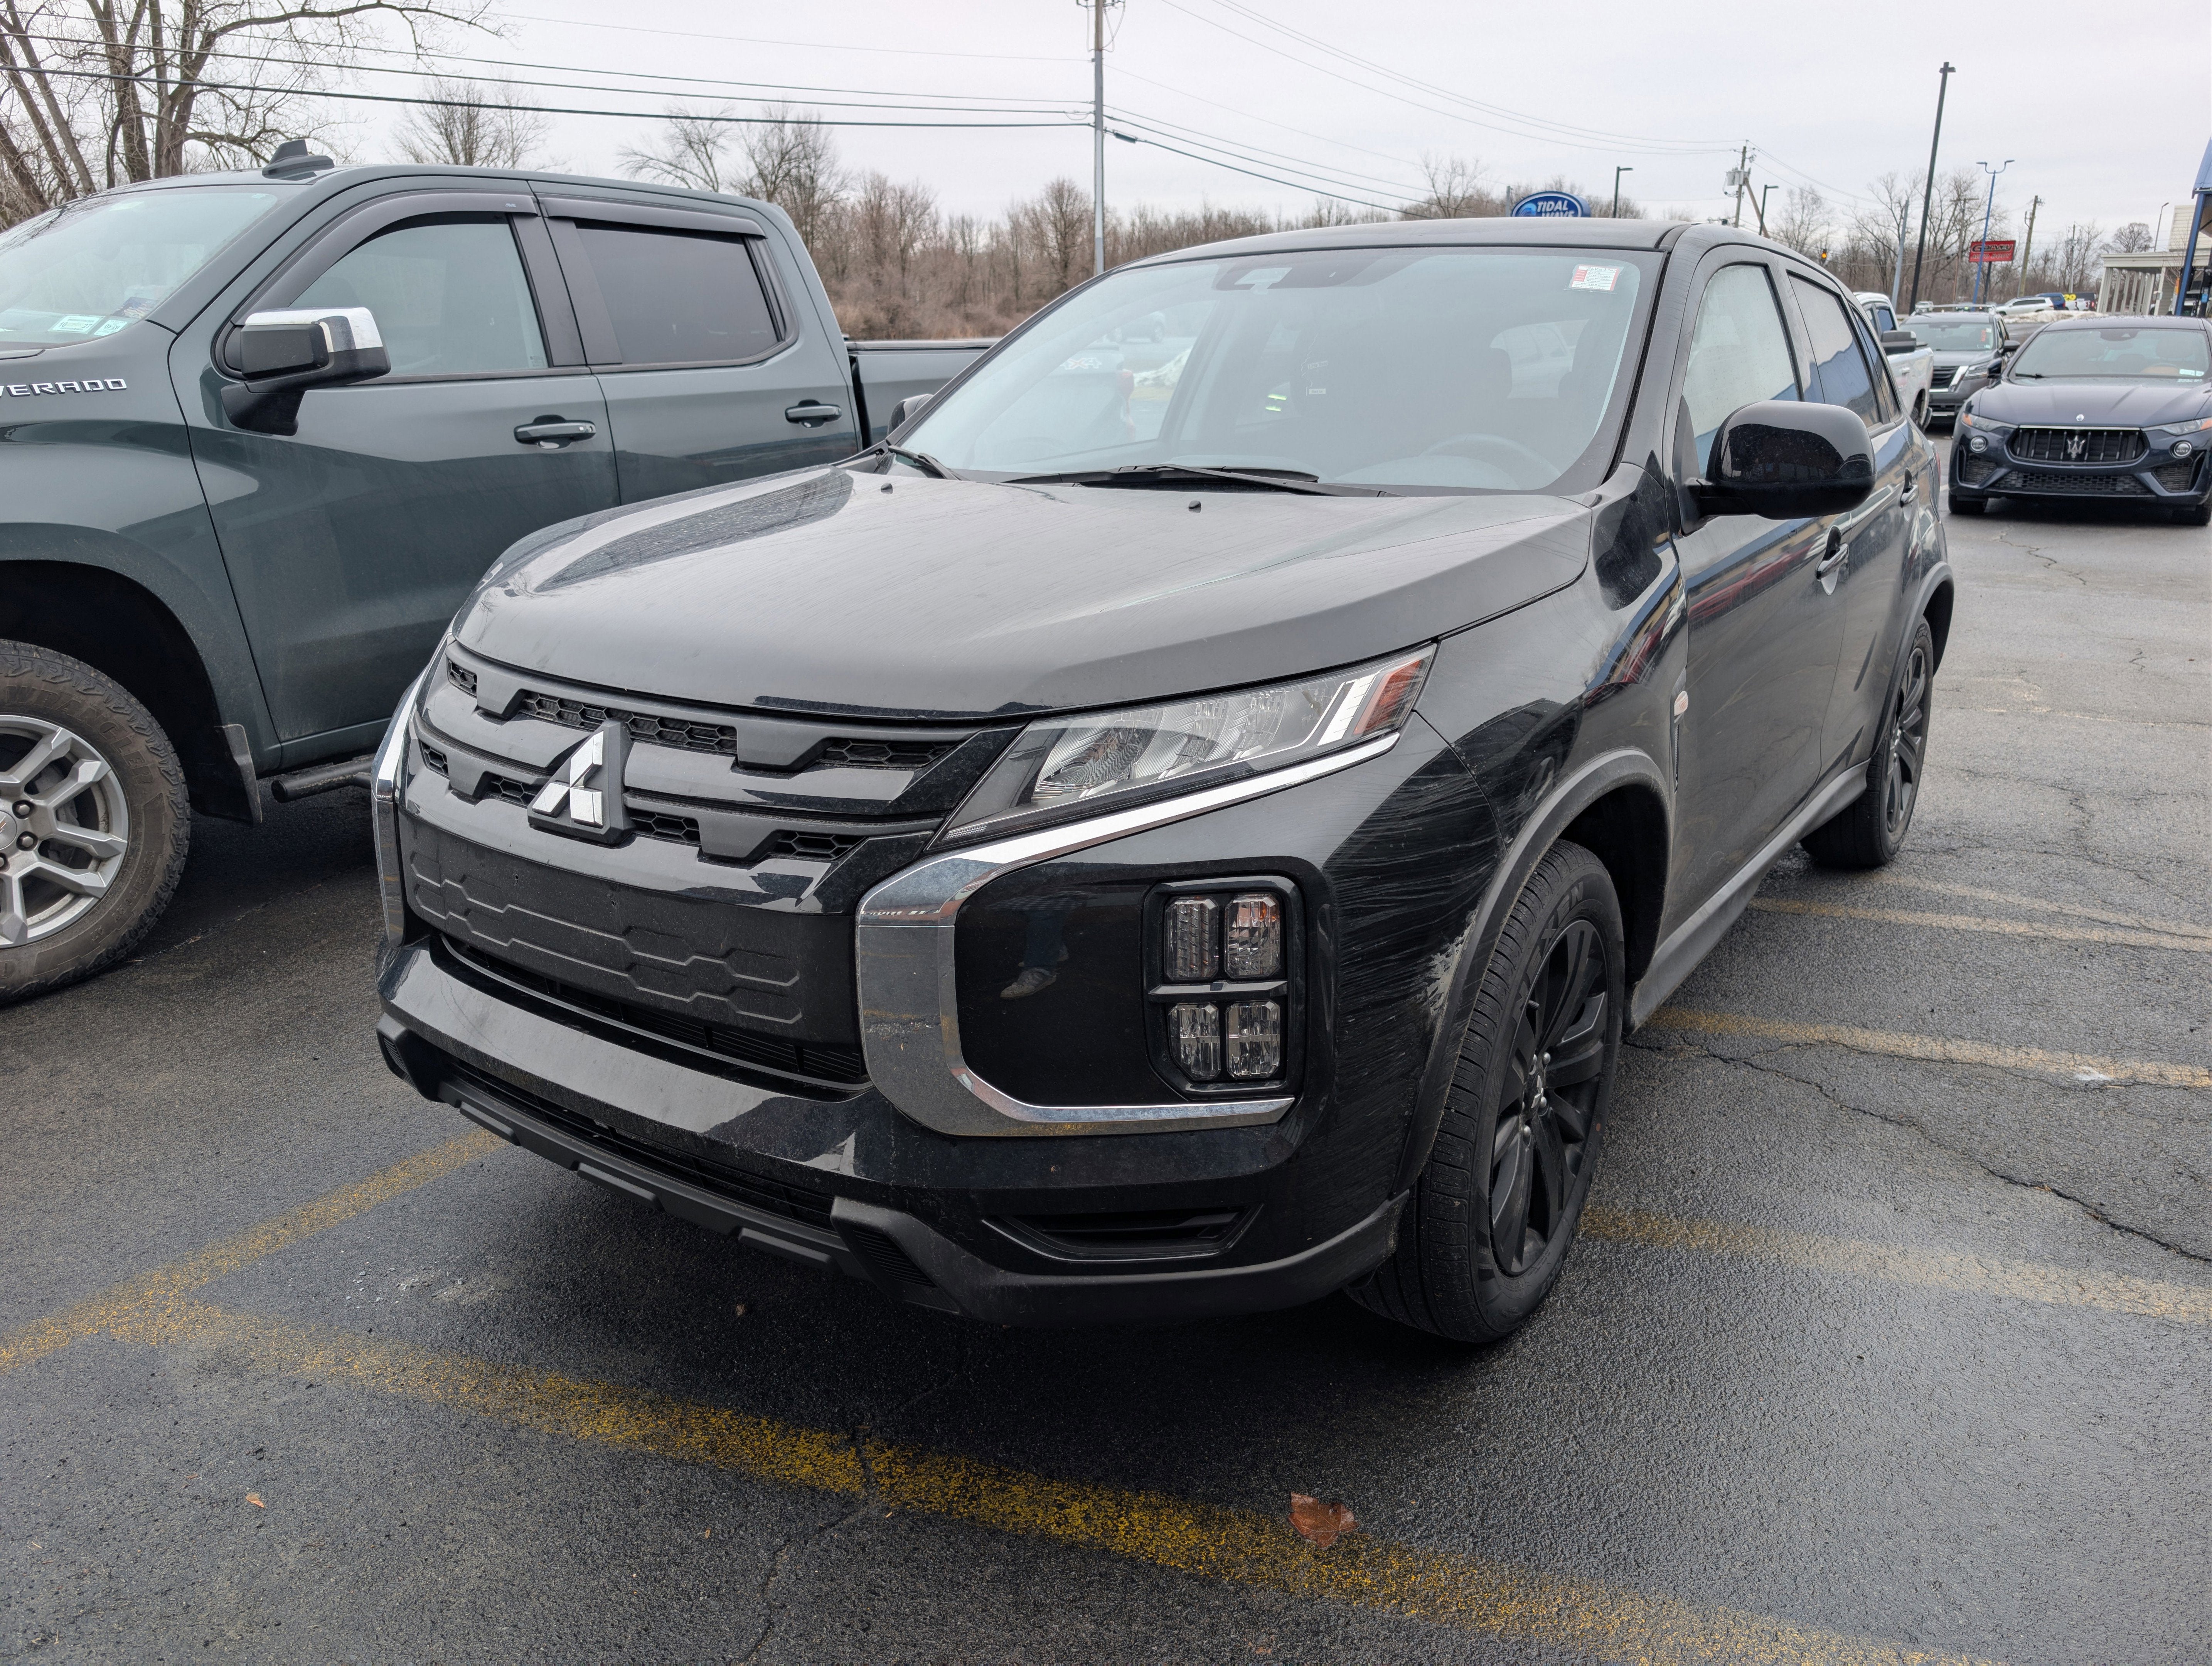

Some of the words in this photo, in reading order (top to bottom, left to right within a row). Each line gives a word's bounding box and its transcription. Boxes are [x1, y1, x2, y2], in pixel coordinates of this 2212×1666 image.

[1537, 200, 1568, 212] TIDAL
[0, 378, 127, 398] ERADO
[6, 685, 155, 785] WRANGLER
[111, 850, 155, 923] TERRITORY
[89, 925, 105, 942] AT
[1511, 881, 1584, 1026] NEXEN
